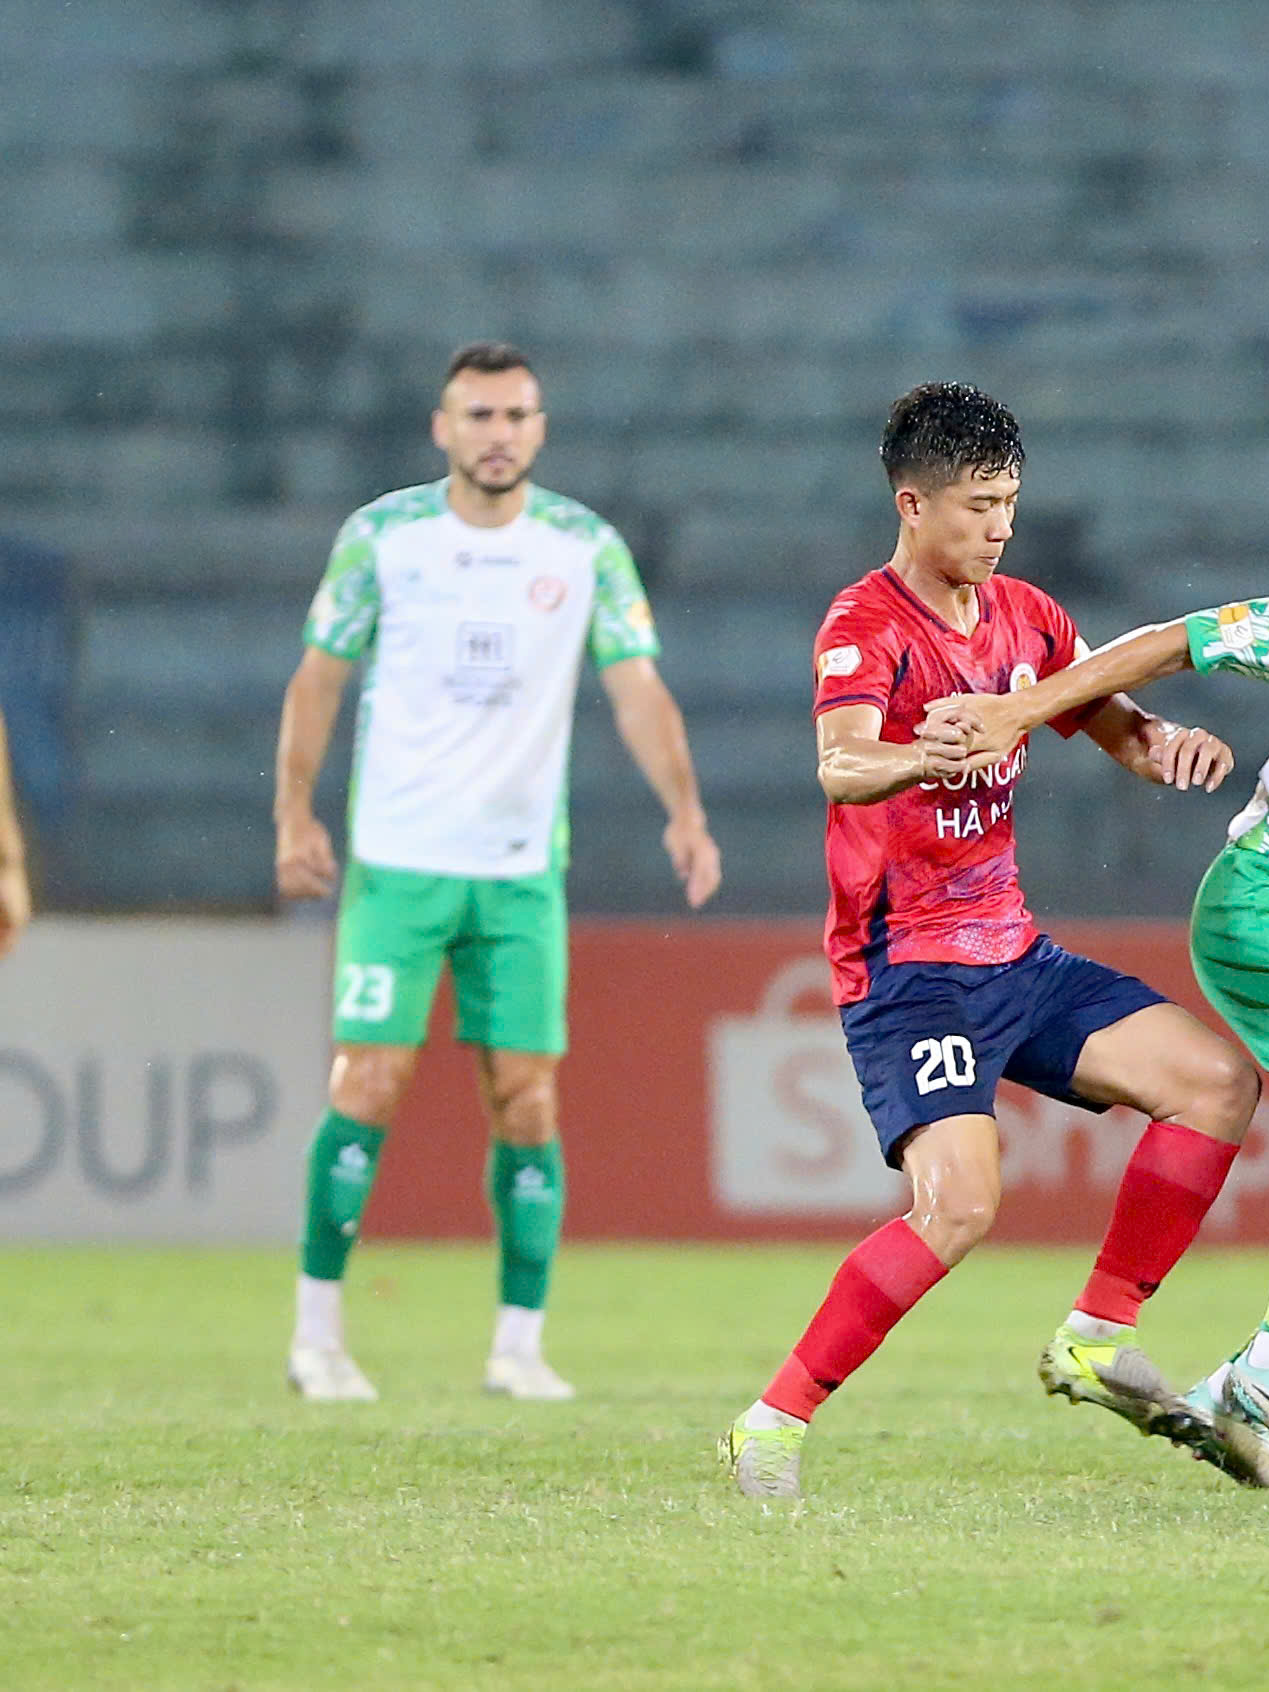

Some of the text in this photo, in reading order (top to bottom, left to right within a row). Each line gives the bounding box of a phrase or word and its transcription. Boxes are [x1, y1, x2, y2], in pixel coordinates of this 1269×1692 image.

[936, 800, 985, 839] HÀ
[335, 963, 395, 1022] 23
[911, 1035, 977, 1096] 20
